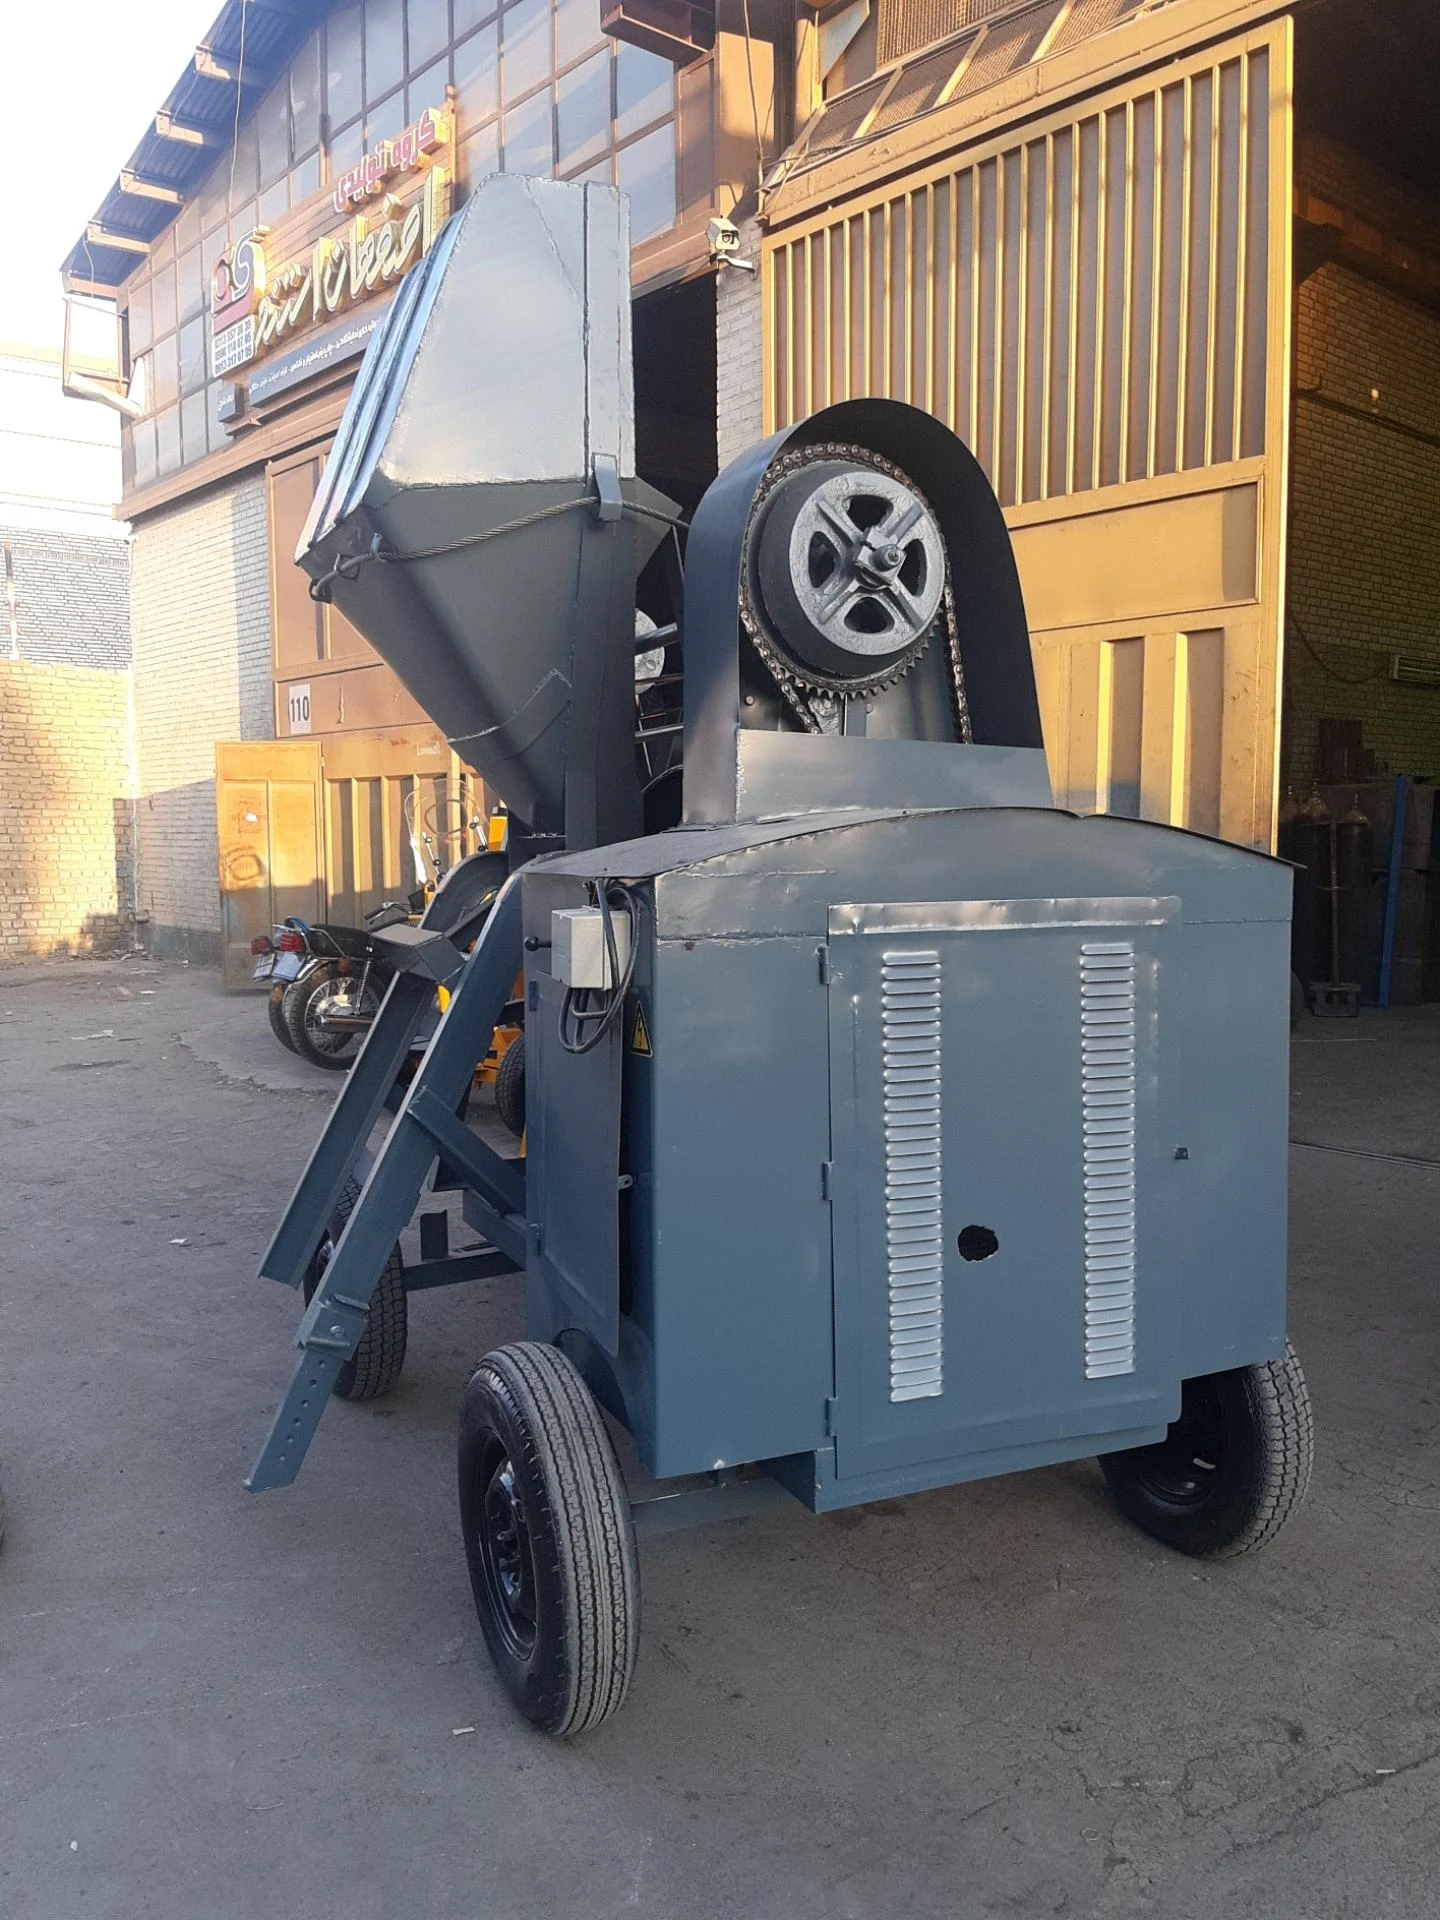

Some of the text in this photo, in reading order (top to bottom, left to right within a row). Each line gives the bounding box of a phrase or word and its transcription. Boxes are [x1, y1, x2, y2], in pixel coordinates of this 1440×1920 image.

[333, 107, 439, 213] گروه تولیدی
[323, 166, 441, 312] اصفهان
[290, 695, 310, 722] 110
